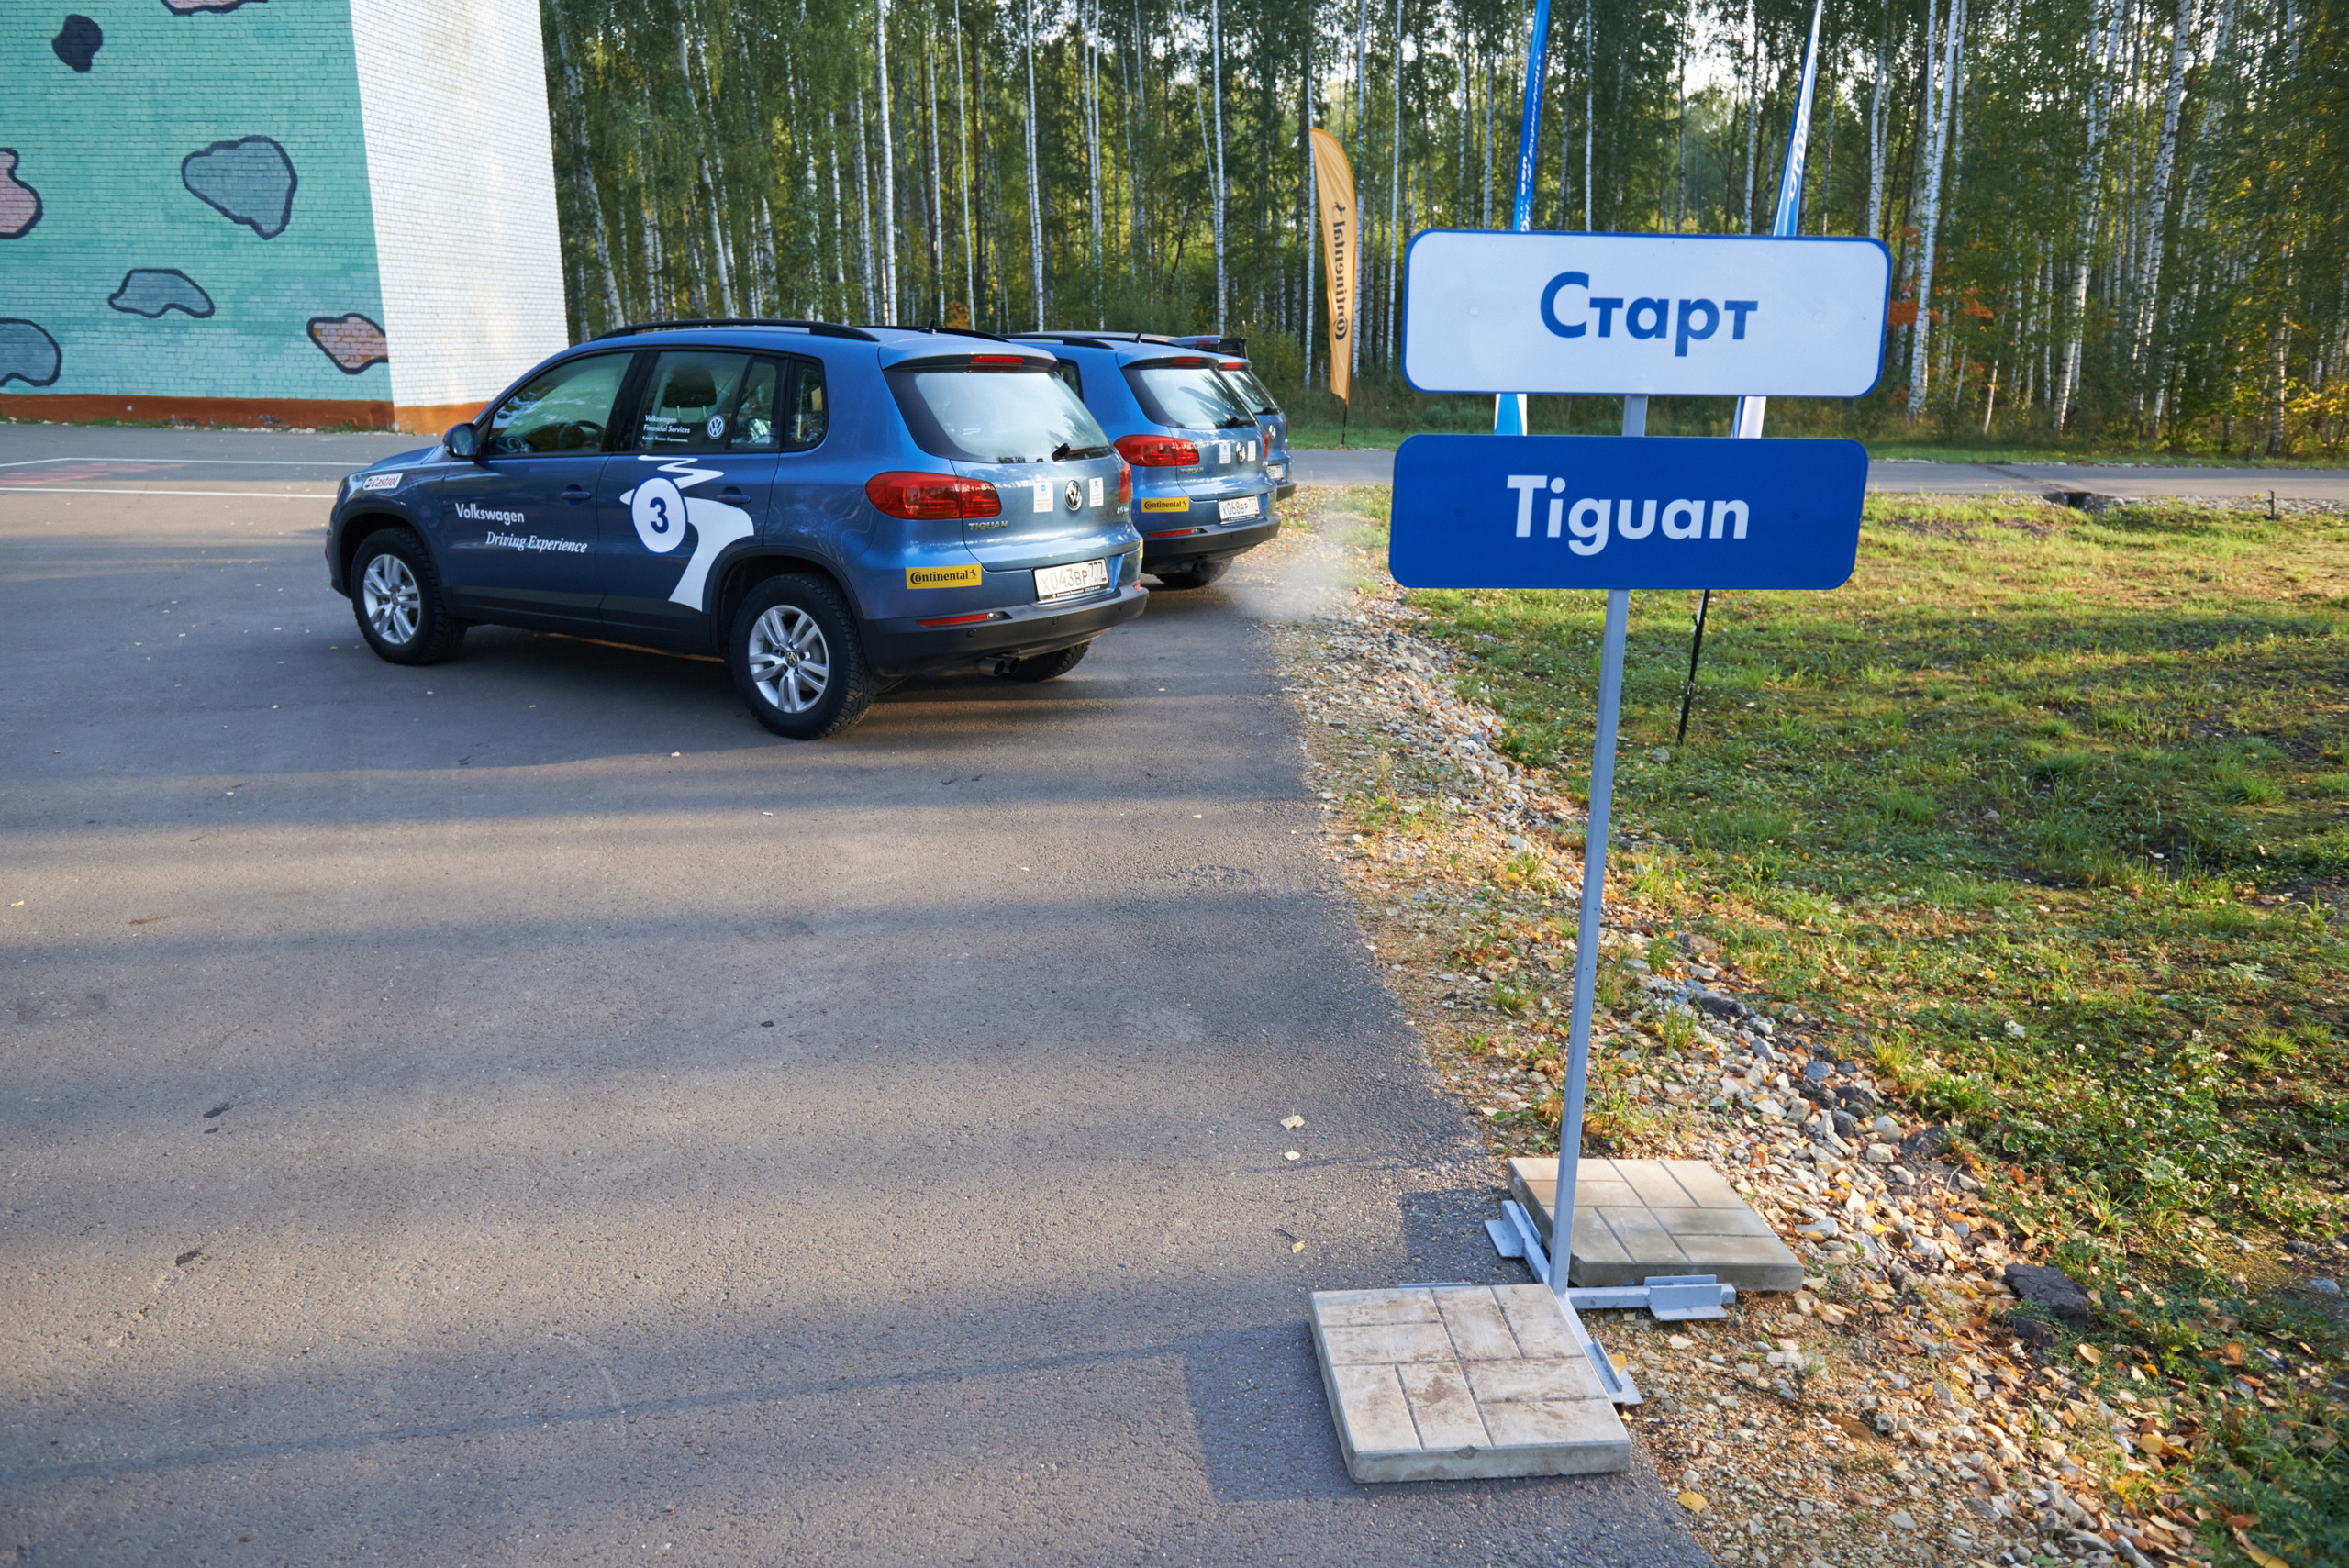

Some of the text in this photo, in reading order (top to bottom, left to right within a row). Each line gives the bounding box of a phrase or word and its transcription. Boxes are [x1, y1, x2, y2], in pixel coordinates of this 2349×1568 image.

[1540, 271, 1759, 357] Старт
[645, 415, 676, 424] Volkswagen
[643, 424, 690, 433] Financial Services
[371, 476, 399, 487] Castrol
[1144, 500, 1182, 510] Continental
[455, 503, 525, 525] Volkswagen
[649, 496, 669, 534] 3
[1507, 475, 1750, 556] Tiguan
[968, 520, 1008, 530] TIGUAN
[485, 531, 588, 553] Driving Experience
[1088, 562, 1103, 577] 777
[910, 570, 968, 584] Continental
